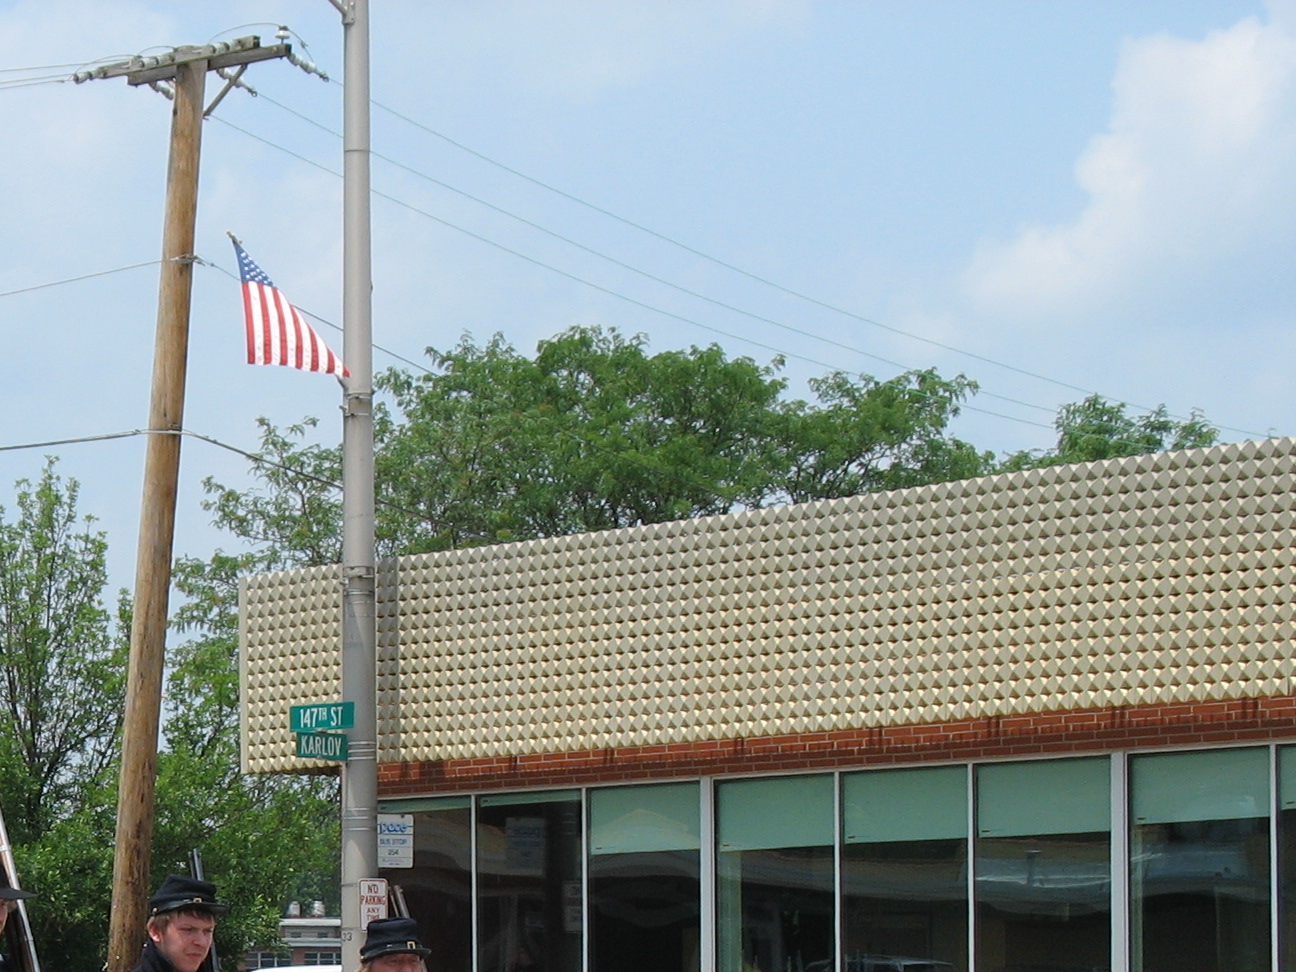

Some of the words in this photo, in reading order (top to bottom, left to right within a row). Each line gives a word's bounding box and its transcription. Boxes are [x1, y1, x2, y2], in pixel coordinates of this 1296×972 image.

[300, 707, 327, 728] 147TH
[330, 706, 343, 726] ST
[367, 884, 379, 894] NO
[360, 895, 386, 905] PARKING
